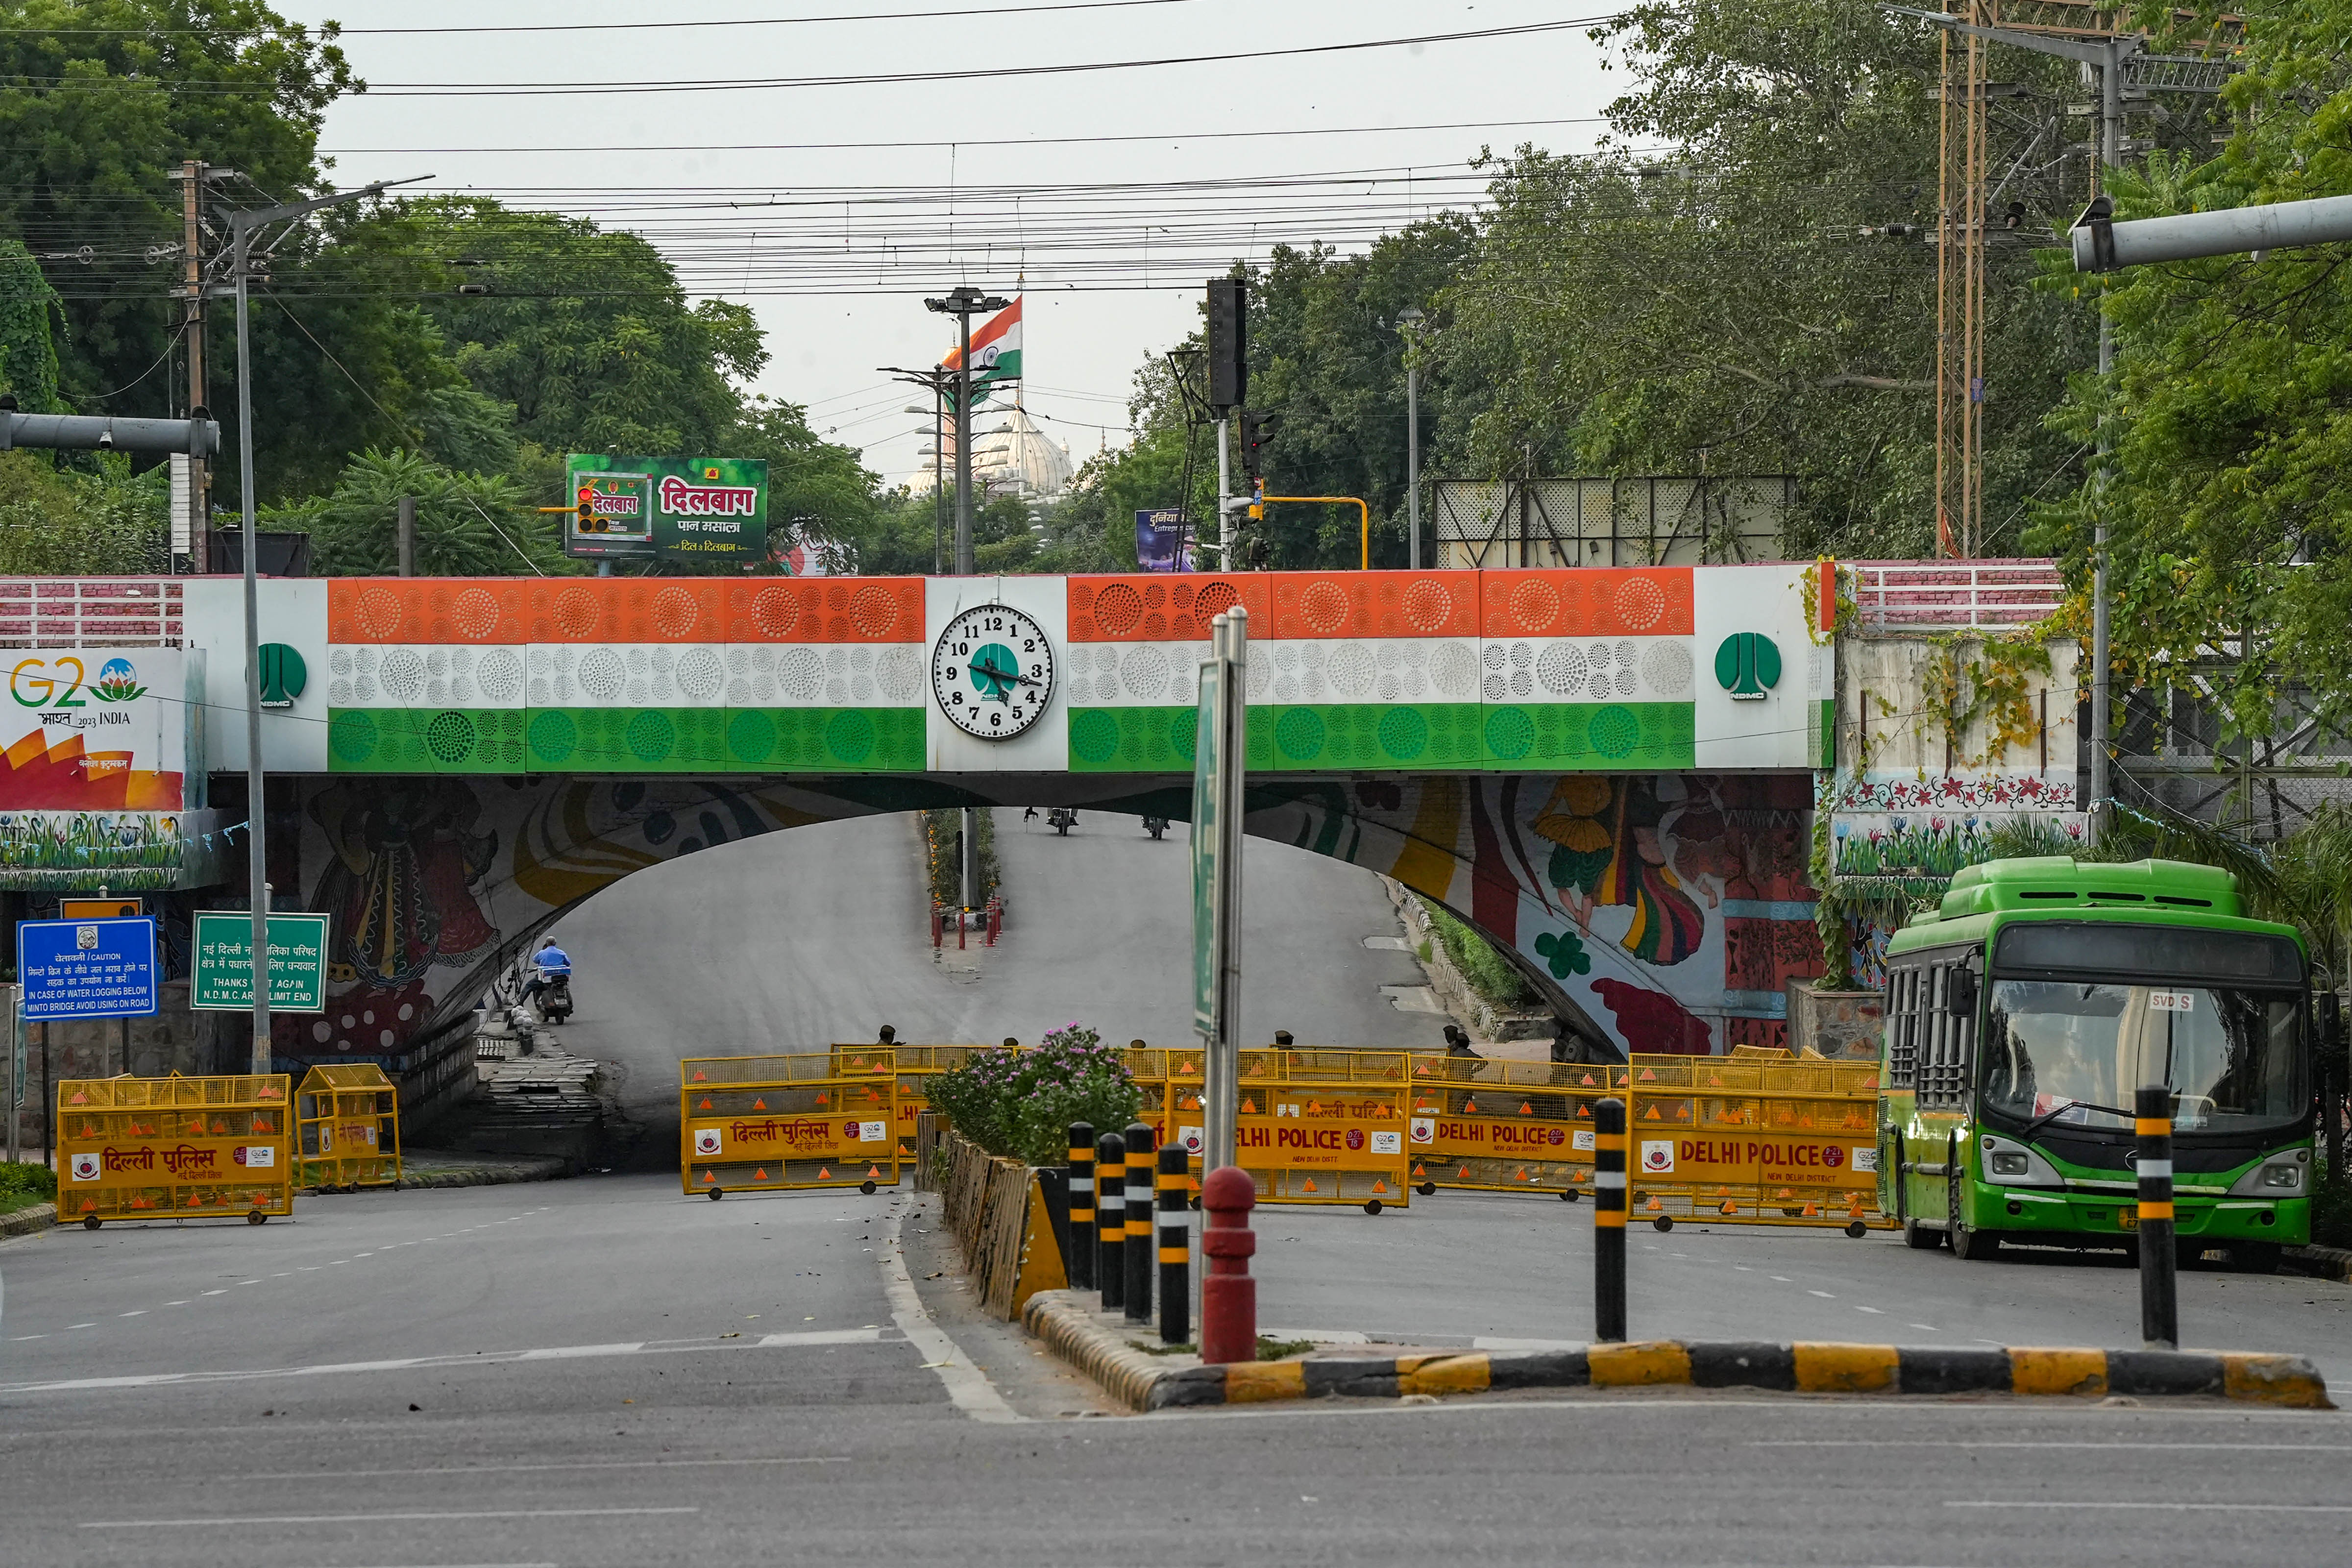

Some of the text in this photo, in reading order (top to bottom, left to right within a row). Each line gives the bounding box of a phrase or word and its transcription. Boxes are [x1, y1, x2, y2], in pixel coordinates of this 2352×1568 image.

[662, 478, 754, 513] दिलबाग
[677, 520, 741, 533] पान मसाला
[1149, 512, 1178, 527] दुनिया
[681, 539, 697, 551] दिल
[704, 539, 736, 552] दिलबाग
[984, 617, 1003, 631] 12
[1009, 624, 1018, 637] 1
[964, 625, 979, 638] 11
[951, 642, 968, 656] 10
[1024, 639, 1035, 653] 2
[946, 666, 957, 680] 9
[1031, 664, 1042, 677] 3
[952, 691, 963, 705] 8
[1025, 690, 1037, 703] 4
[969, 706, 980, 720] 7
[990, 712, 1001, 726] 6
[1012, 706, 1023, 719] 5
[78, 717, 97, 728] 2023
[99, 712, 130, 725] INDIA
[202, 942, 215, 955] नई
[219, 942, 241, 955] दिल्ली
[293, 944, 317, 956] परिषद
[55, 952, 85, 962] चेतावनी
[201, 956, 215, 968] क्षेत्र
[269, 958, 285, 972] लिए
[288, 962, 317, 971] धन्यवाद
[28, 966, 45, 976] मिन्टो
[64, 965, 72, 975] के
[75, 964, 87, 974] नीचे
[124, 962, 136, 973] होने
[80, 974, 101, 985] उपयोग
[213, 978, 247, 987] THANKS
[276, 980, 304, 988] AGAIN
[29, 986, 147, 1000] IN CASE OF WATER LOGGING BELOW
[203, 990, 240, 1000] N.D.M.C.
[269, 992, 291, 1001] LIMIT
[294, 993, 312, 1002] END
[27, 998, 149, 1012] MINTO BRIDGE AVOID USING ON ROAD
[2153, 995, 2190, 1009] SVD S
[729, 1120, 779, 1145] दिल्ली
[779, 1118, 830, 1145] पुलिस
[1439, 1123, 1484, 1141] DELHI
[1492, 1125, 1547, 1145] POLICE
[793, 1140, 839, 1152] नई दिल्ली जिला
[1278, 1128, 1342, 1150] POLICE
[101, 1146, 155, 1173] दिल्ली
[160, 1144, 217, 1174] पुलिस
[1681, 1140, 1740, 1164] DELHI
[1747, 1142, 1819, 1166] POLICE
[177, 1169, 222, 1180] नई दिल्ली जिला
[1767, 1172, 1837, 1183] NEW DELHI DISTRICT
